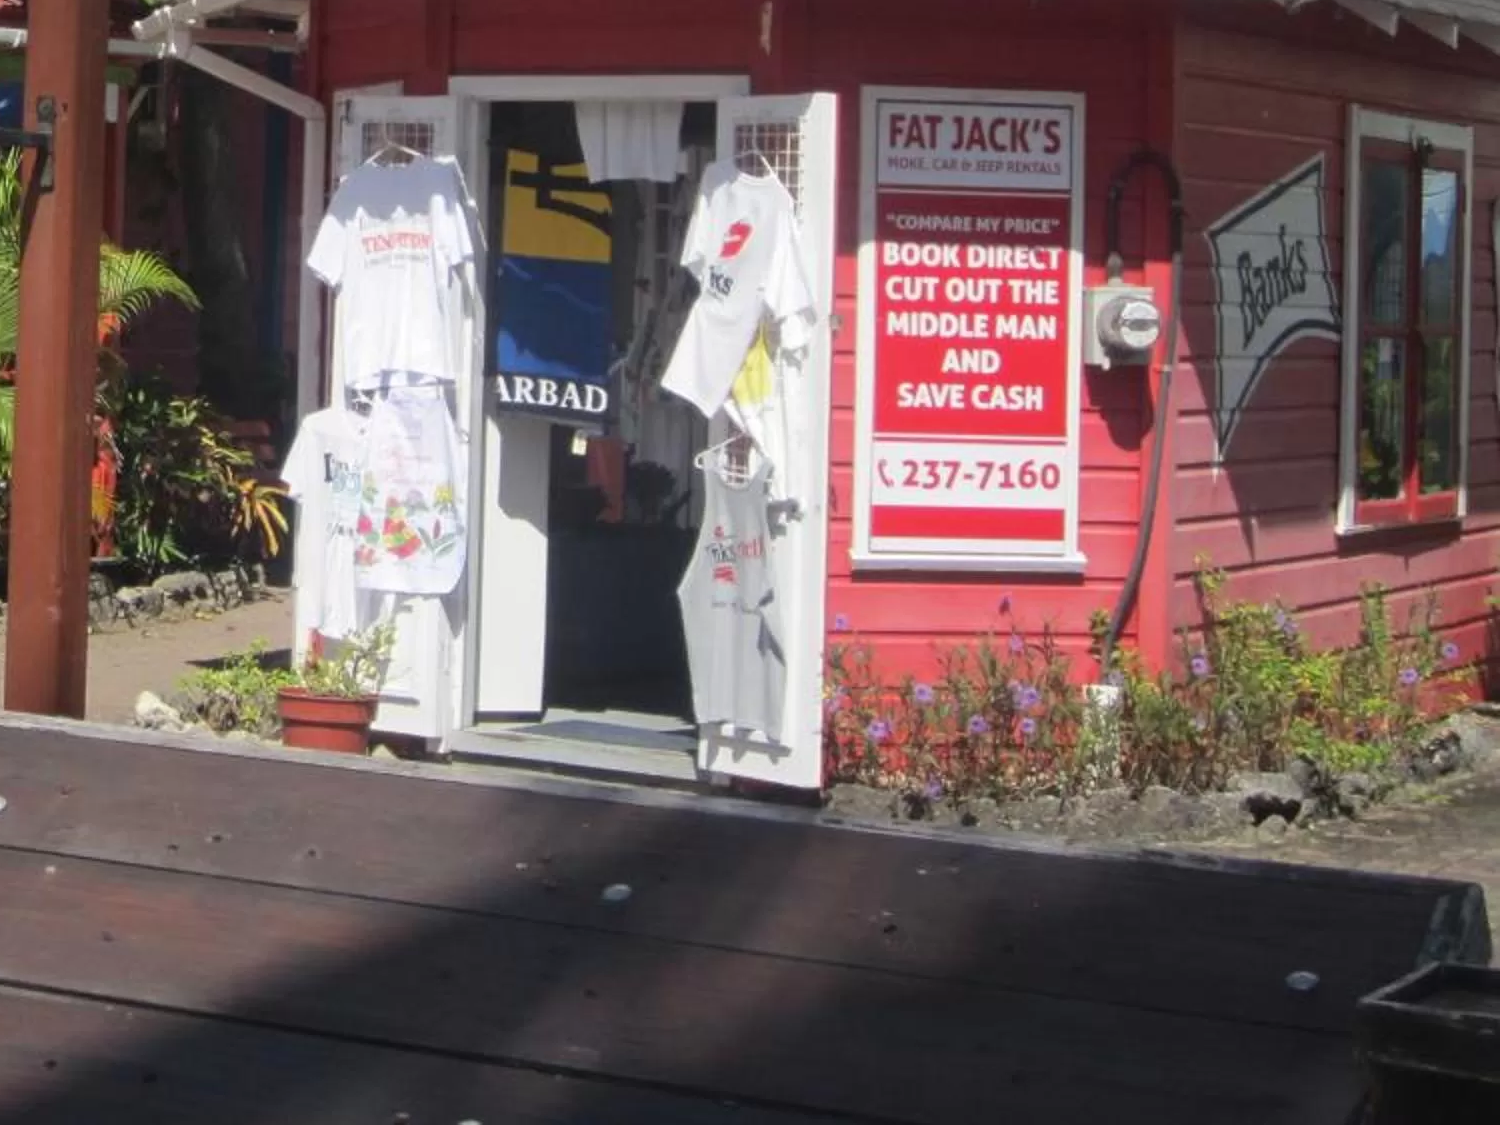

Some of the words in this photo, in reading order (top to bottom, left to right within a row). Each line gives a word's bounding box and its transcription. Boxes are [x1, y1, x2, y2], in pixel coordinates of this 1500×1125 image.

[889, 114, 943, 150] FAT
[951, 116, 1061, 154] JACK'S
[932, 157, 960, 172] CAR
[975, 159, 1003, 173] JEEP
[1006, 159, 1061, 176] RENTALS
[975, 217, 1002, 232] MY
[883, 241, 961, 268] BOOK
[967, 244, 1062, 270] DIRECT
[884, 276, 939, 302] CUT
[945, 277, 1003, 304] OUT
[1008, 279, 1060, 305] THE
[1236, 223, 1308, 352] Banks
[886, 311, 989, 338] MIDDLE
[995, 315, 1057, 340] MAN
[941, 348, 1001, 374] AND
[897, 382, 965, 408] SAVE
[971, 384, 1044, 411] CASH
[902, 459, 1060, 490] 237-7160
